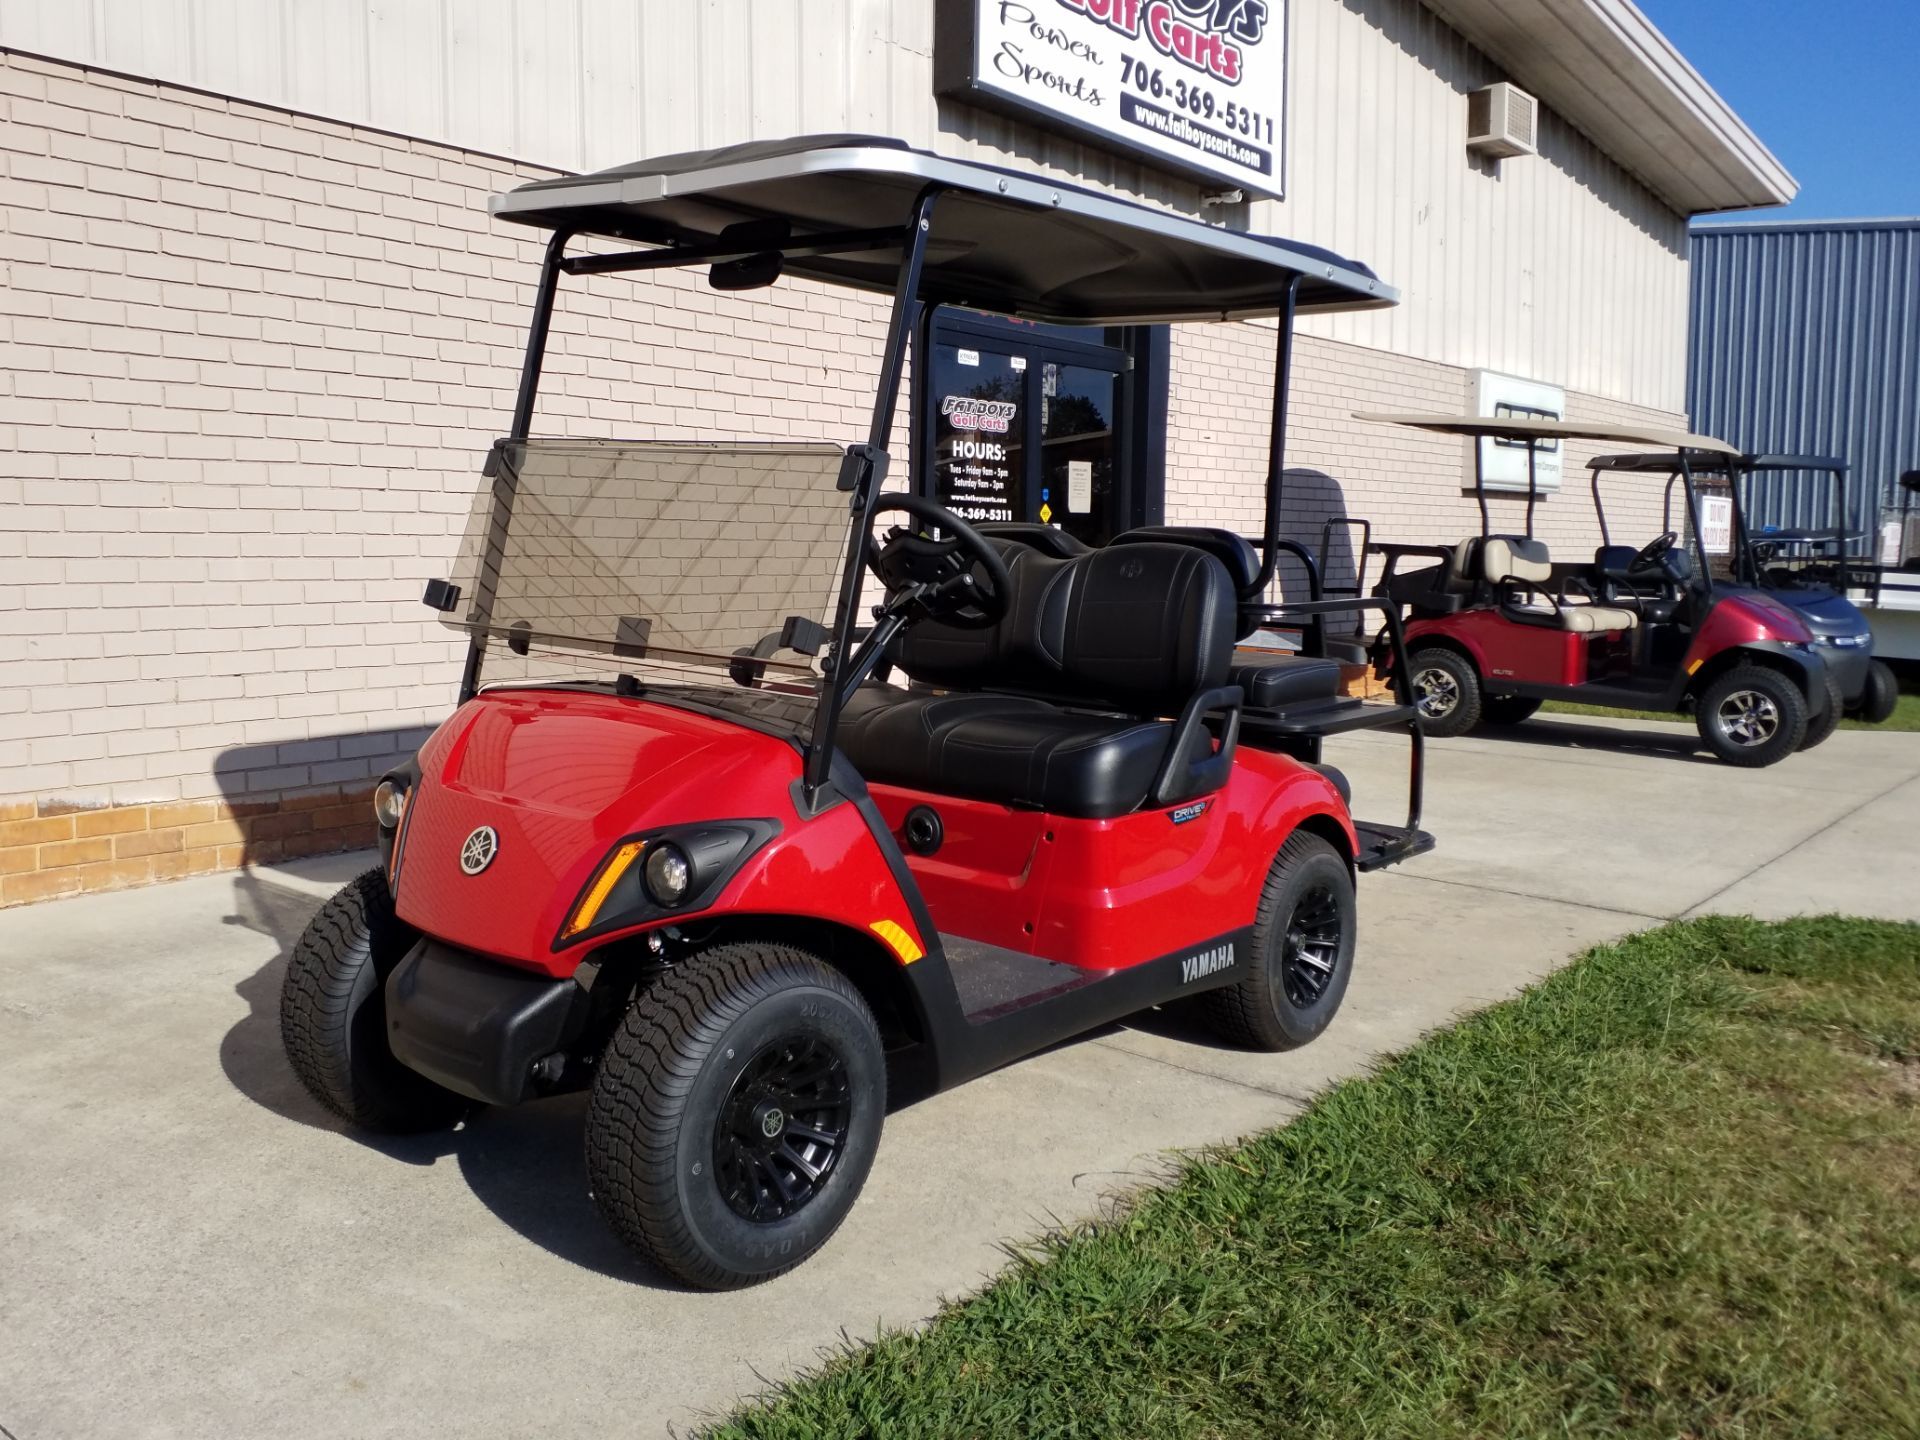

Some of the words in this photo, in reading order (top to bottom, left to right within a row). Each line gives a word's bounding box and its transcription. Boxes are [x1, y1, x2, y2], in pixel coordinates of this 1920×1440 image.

[997, 1, 1104, 65] Power
[1146, 2, 1241, 83] Carts
[992, 41, 1106, 106] Sports
[1120, 52, 1273, 145] 706-369-5311
[1134, 104, 1261, 168] www.fatboyscarts.com
[943, 398, 976, 414] FAT
[976, 401, 1015, 418] BOYS
[952, 413, 978, 428] Golf
[979, 415, 1007, 431] Carts
[952, 440, 1006, 461] HOURS:
[950, 463, 962, 474] Tues
[965, 465, 982, 477] Friday
[982, 466, 993, 476] 9am
[954, 476, 977, 490] Saturday
[977, 478, 989, 488] 9am
[945, 506, 1013, 521] 06-369-5311
[1182, 942, 1235, 984] YAMAHA
